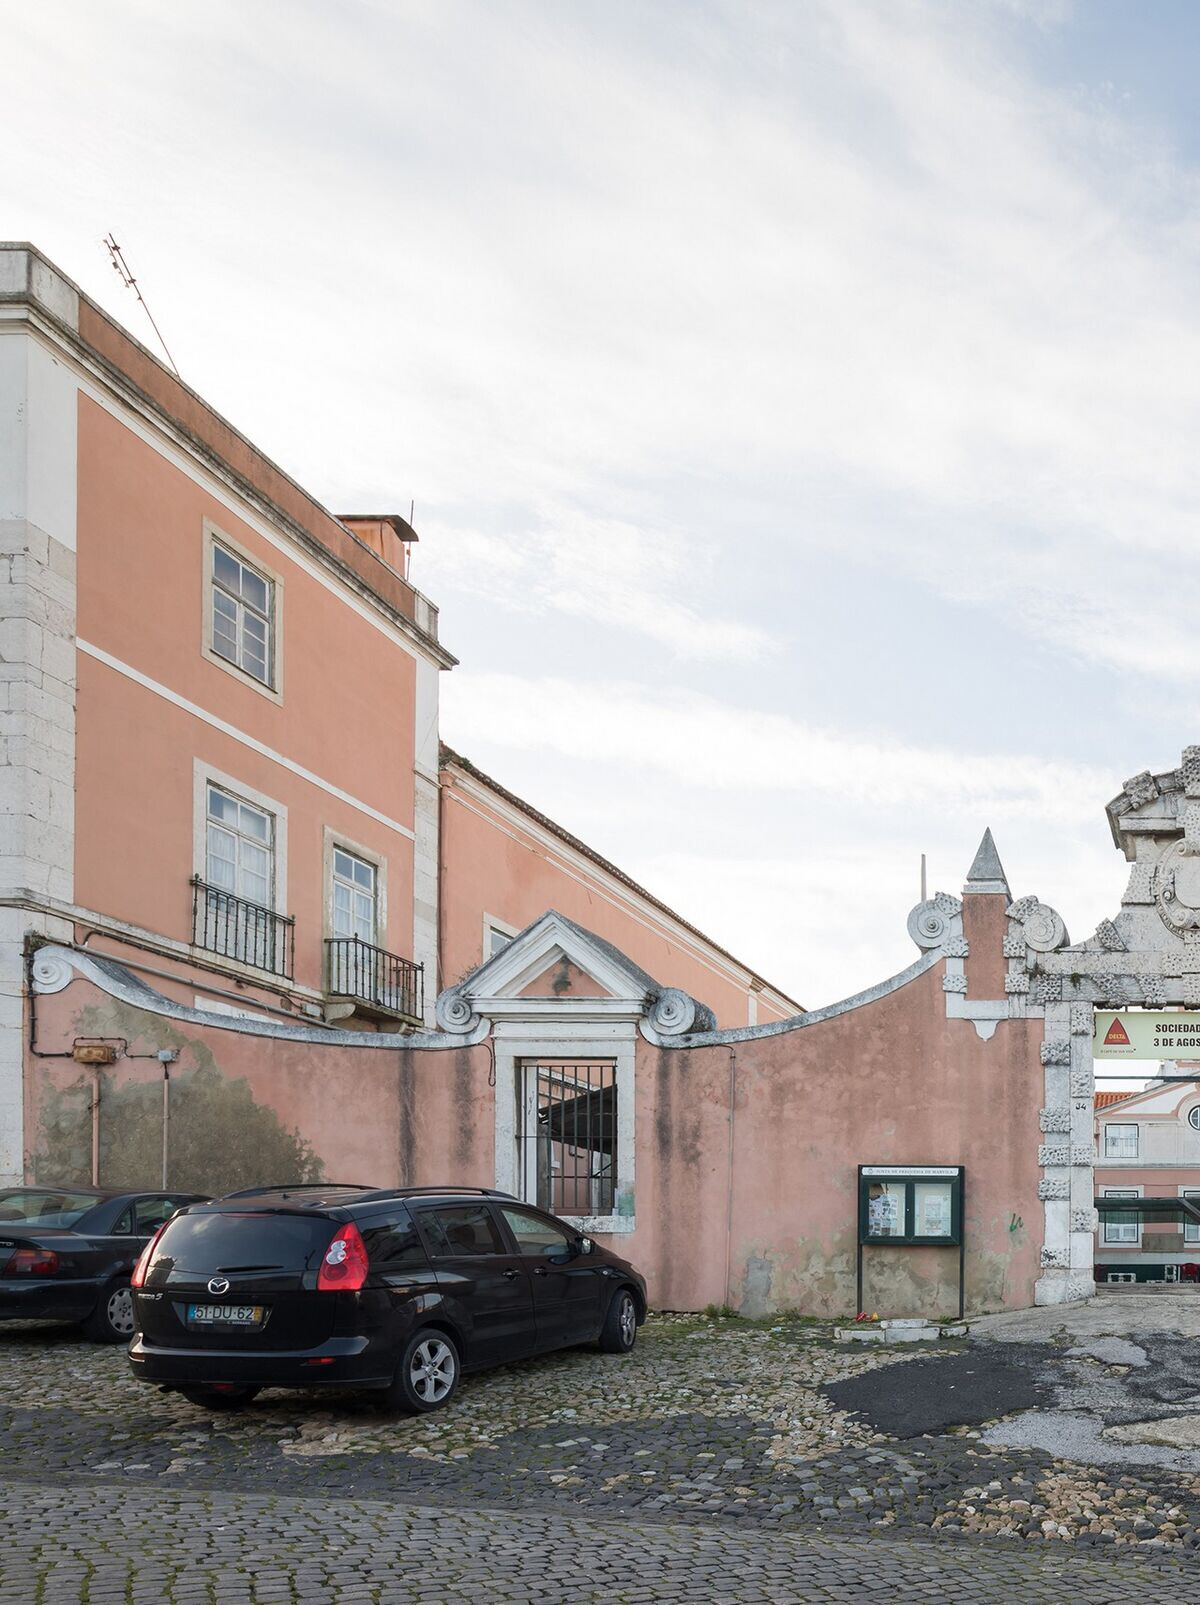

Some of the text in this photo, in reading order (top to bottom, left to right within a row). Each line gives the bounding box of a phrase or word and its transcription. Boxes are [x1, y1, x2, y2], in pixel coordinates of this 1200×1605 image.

[1153, 1038, 1159, 1047] 3
[1162, 1038, 1173, 1047] DE
[196, 1306, 254, 1320] 51-DU-62
